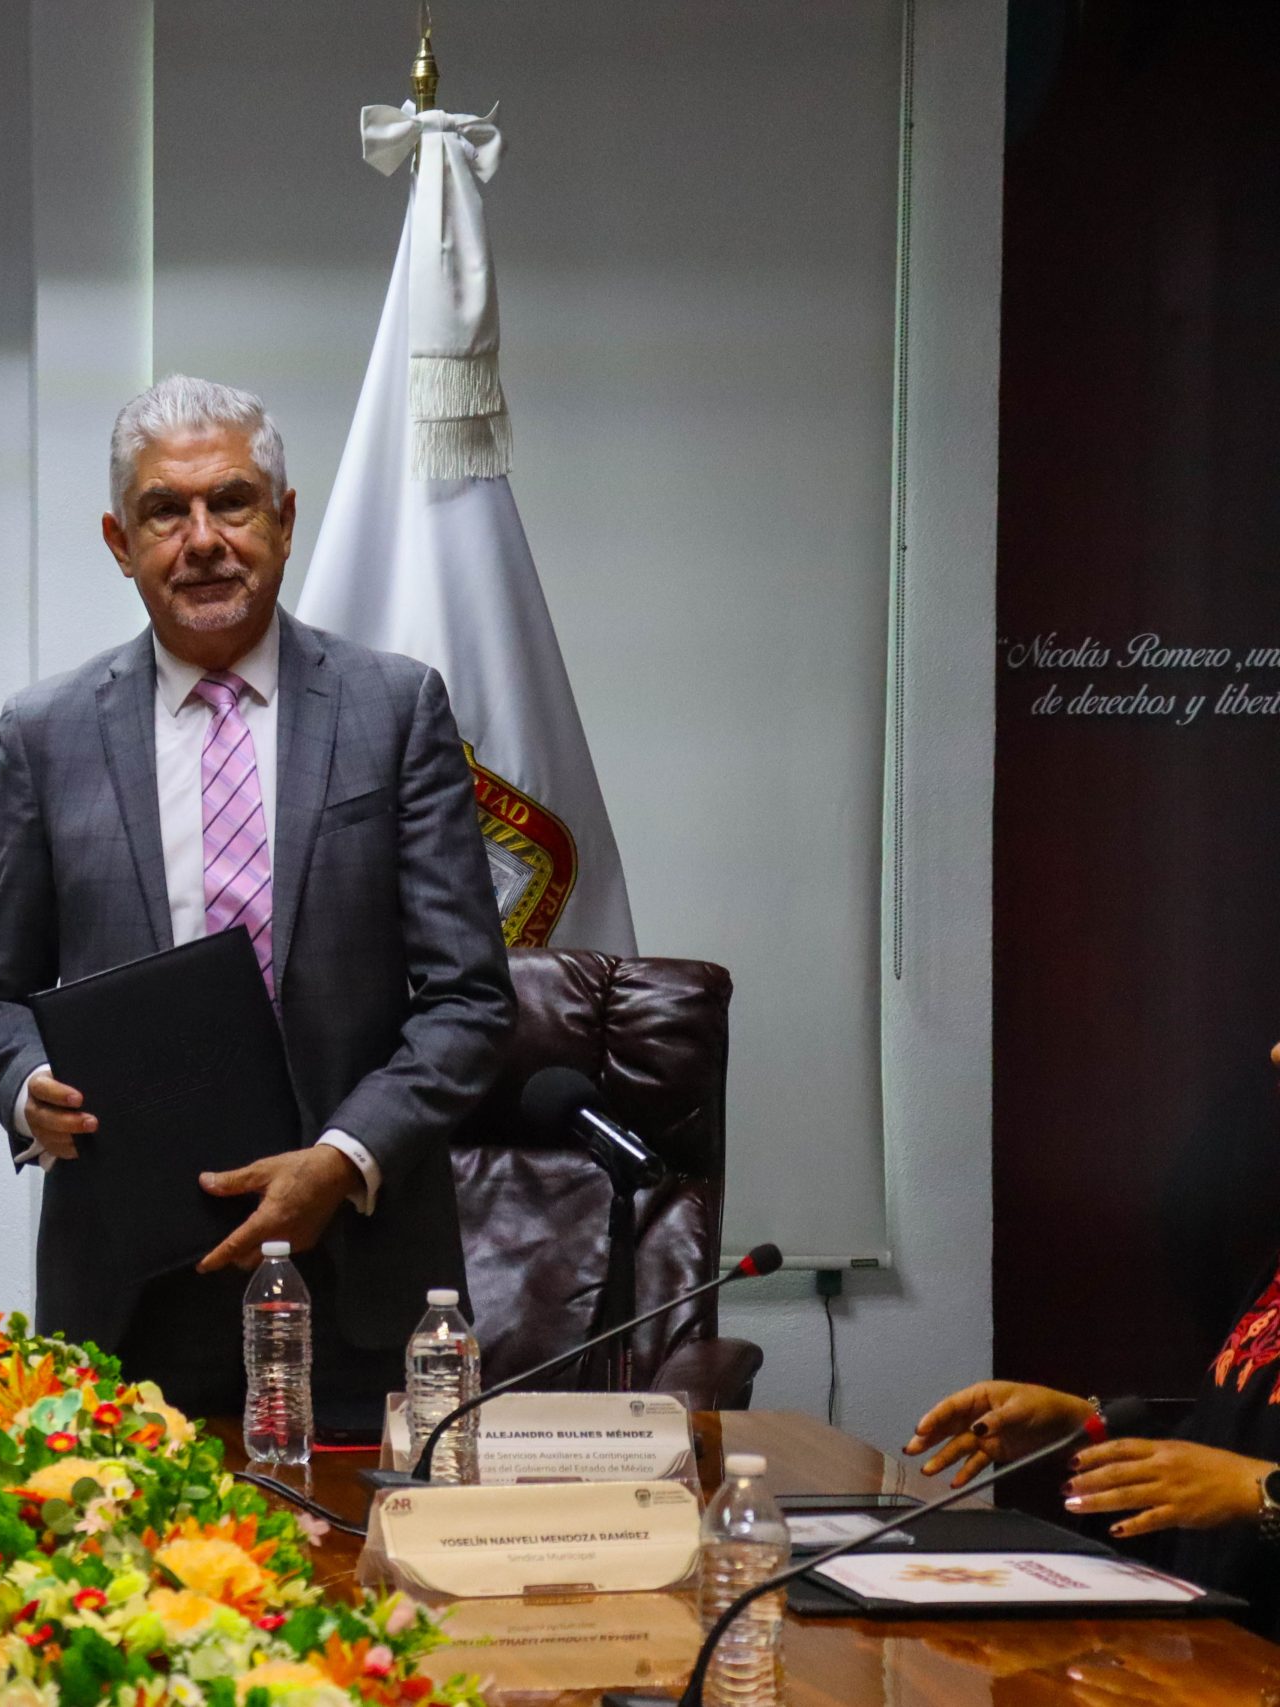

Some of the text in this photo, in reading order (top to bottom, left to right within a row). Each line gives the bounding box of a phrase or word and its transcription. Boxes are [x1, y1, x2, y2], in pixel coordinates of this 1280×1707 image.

[1031, 683, 1280, 726] de derechos y libert
[485, 1431, 554, 1439] ALEJANDRO
[557, 1430, 603, 1439] BULNES
[606, 1428, 654, 1439] MÉNDEZ
[497, 1451, 538, 1460] Servicios
[539, 1450, 583, 1459] Auxiliares
[592, 1451, 657, 1462] Contingencias
[514, 1464, 557, 1473] Gobierno
[559, 1463, 573, 1472] del
[574, 1463, 606, 1473] Estado
[608, 1464, 619, 1472] de
[541, 1533, 597, 1544] MENDOZA
[599, 1530, 651, 1541] RAMÍREZ
